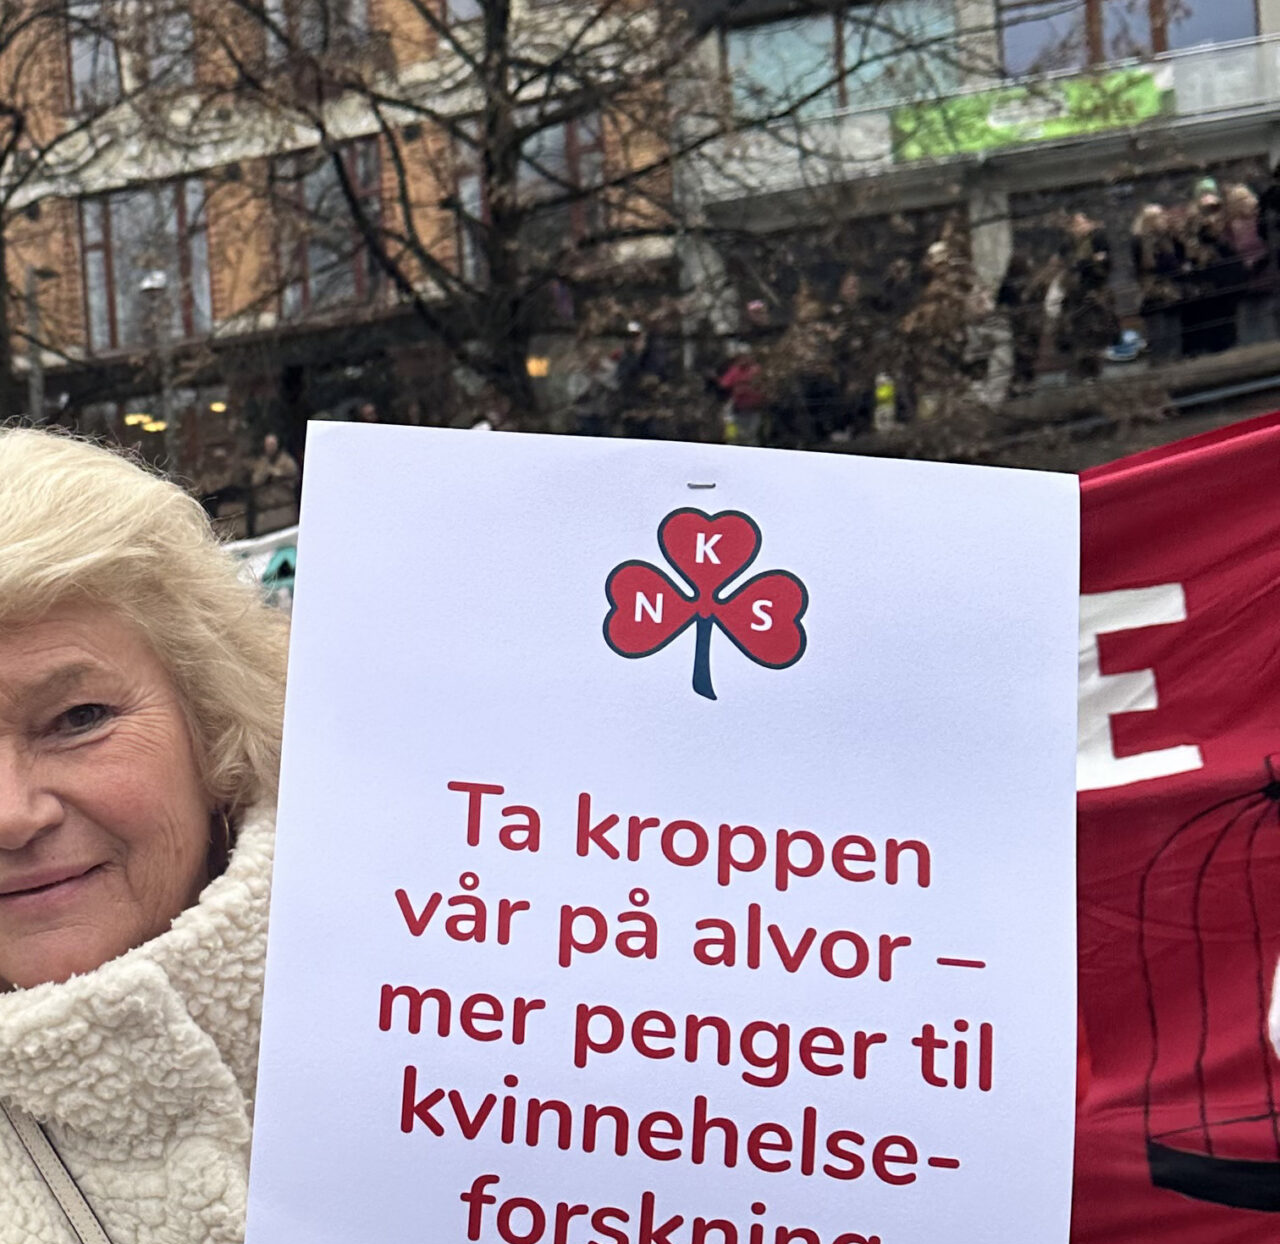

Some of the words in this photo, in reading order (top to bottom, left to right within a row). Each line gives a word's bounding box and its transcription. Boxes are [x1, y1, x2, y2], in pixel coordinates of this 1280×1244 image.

[635, 592, 664, 623] N
[695, 532, 723, 564] K
[750, 599, 774, 631] S
[447, 780, 541, 853] Ta
[576, 792, 931, 892] kroppen
[395, 871, 530, 945] vår
[558, 887, 658, 968] på
[693, 903, 912, 982] alvor
[379, 983, 546, 1045] mer
[574, 1003, 887, 1088] penger
[912, 1019, 993, 1092] til
[400, 1064, 960, 1186] kvinnehelse-
